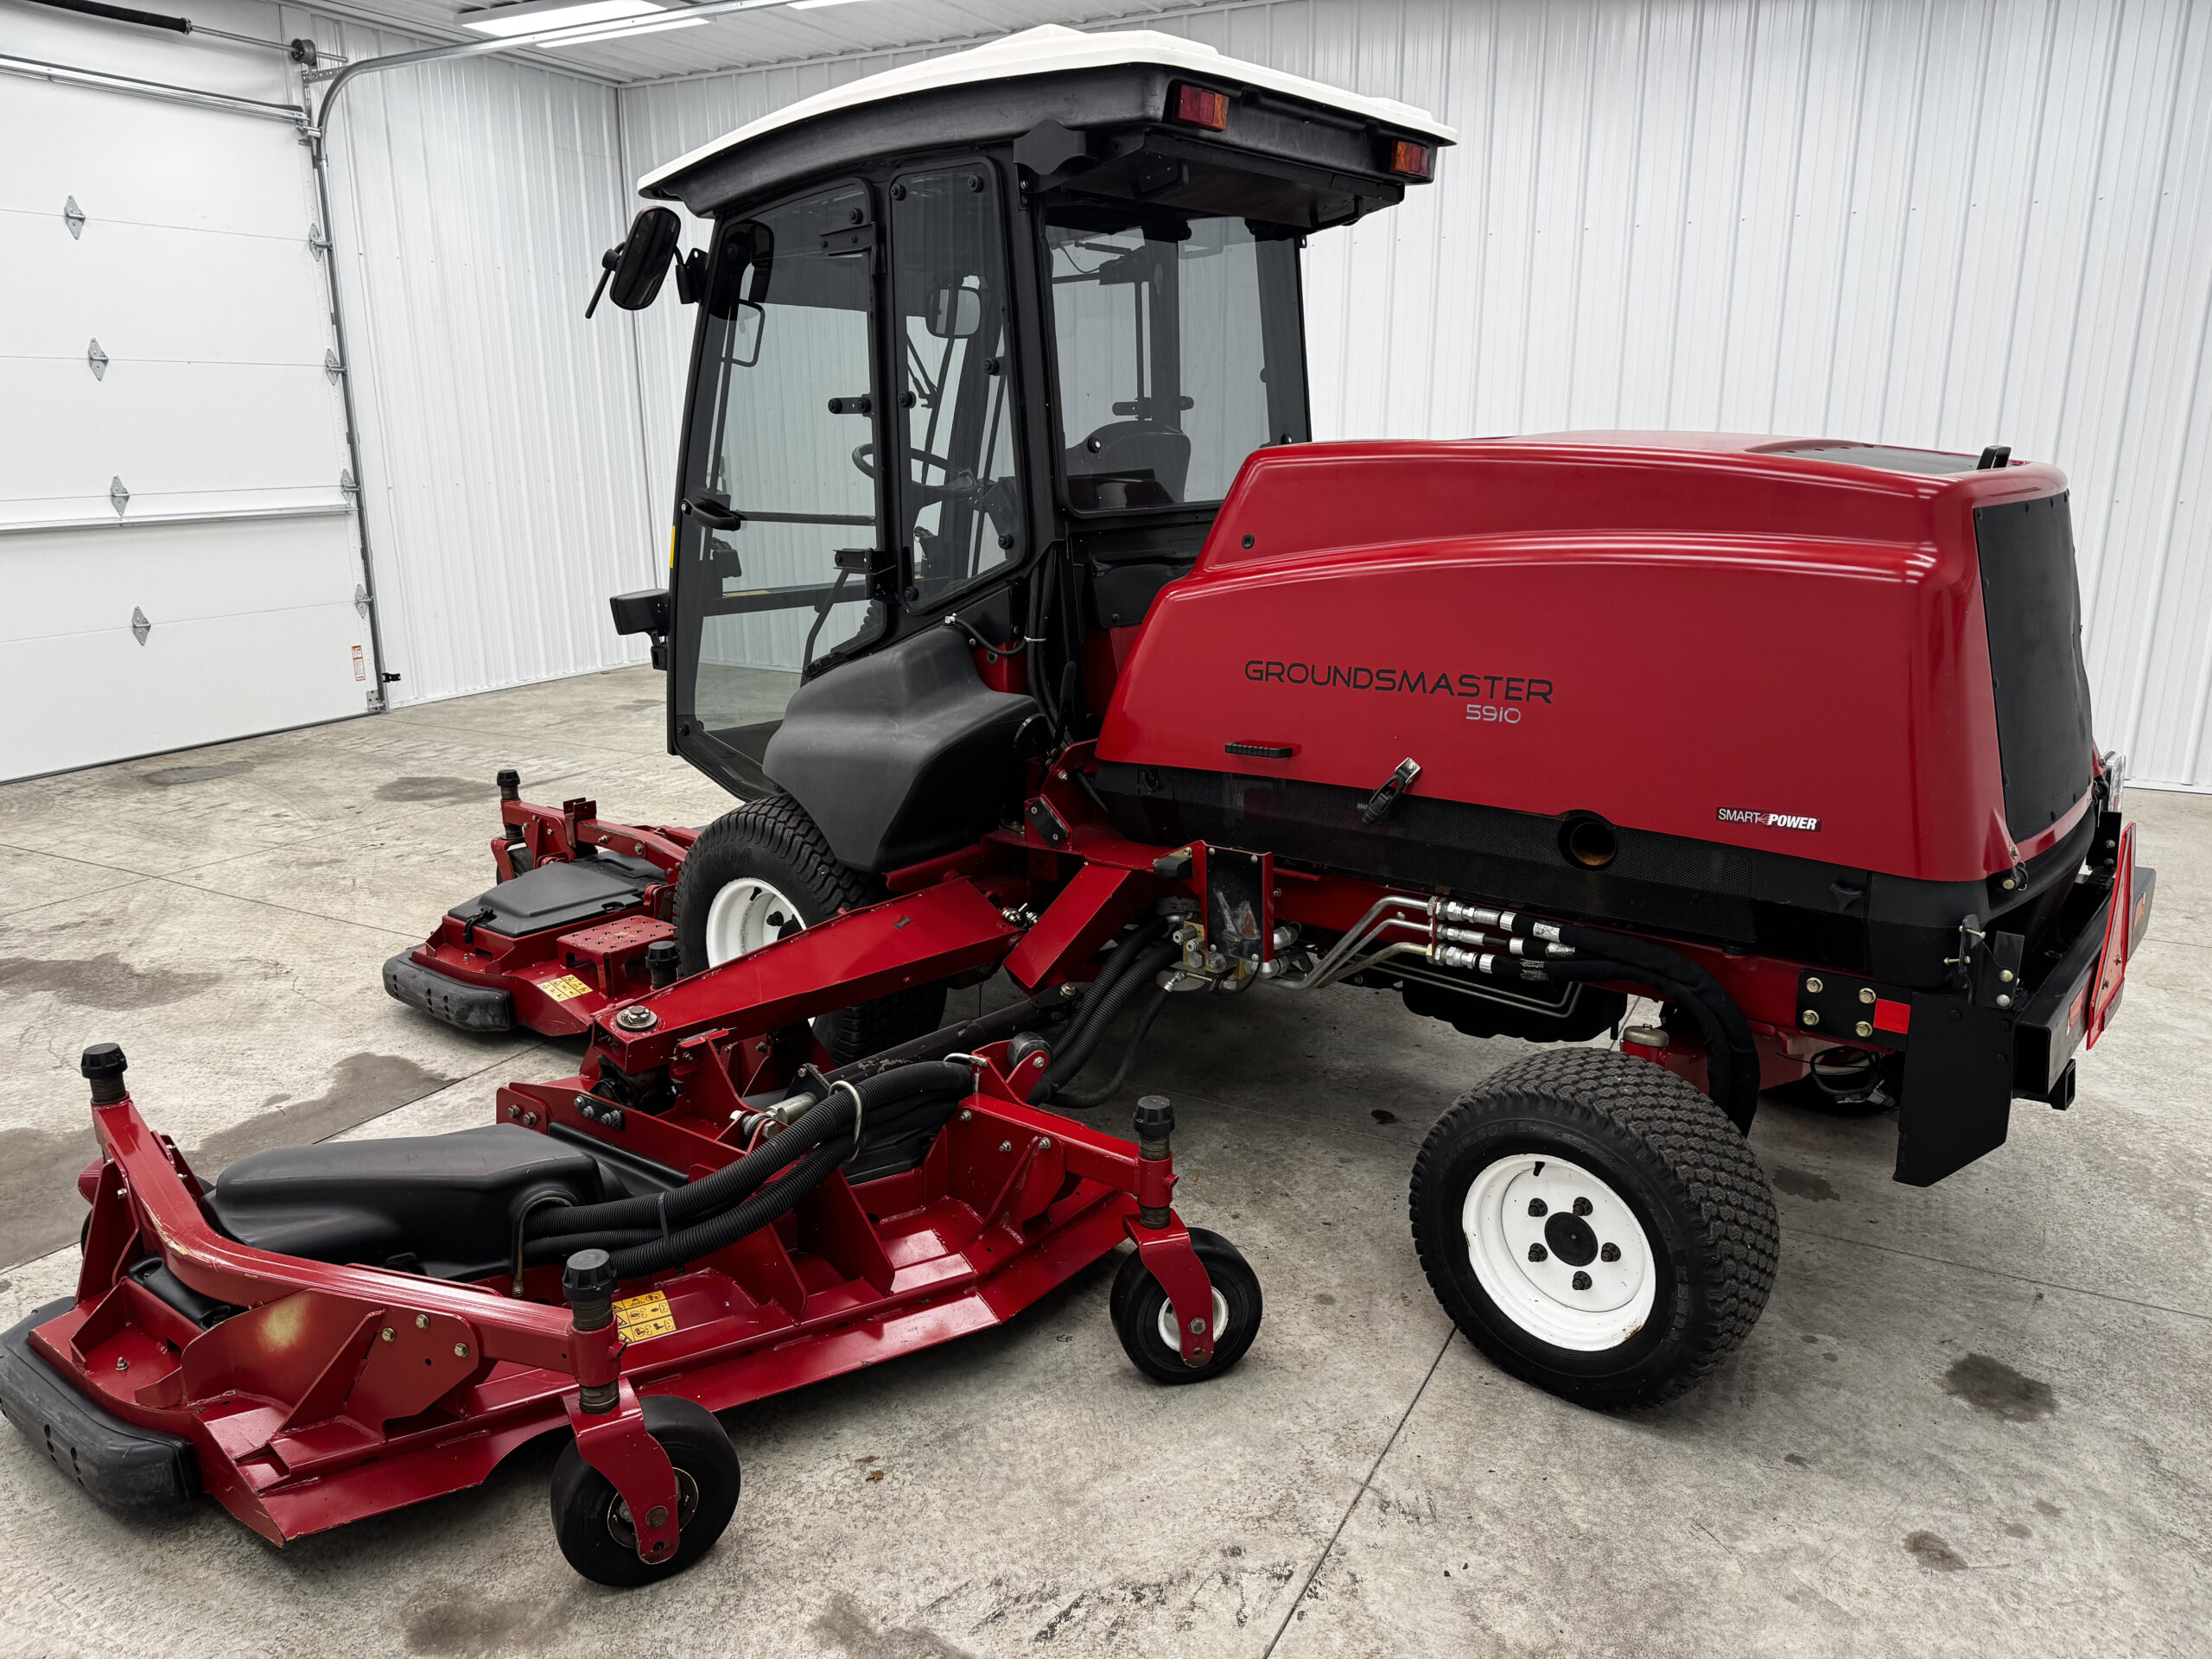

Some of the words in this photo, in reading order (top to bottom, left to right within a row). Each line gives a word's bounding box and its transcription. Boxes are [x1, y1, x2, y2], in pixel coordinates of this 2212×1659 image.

[1244, 659, 1554, 704] GROUNDSMASTER
[1718, 808, 1761, 824] SMART
[1767, 813, 1818, 830] POWER
